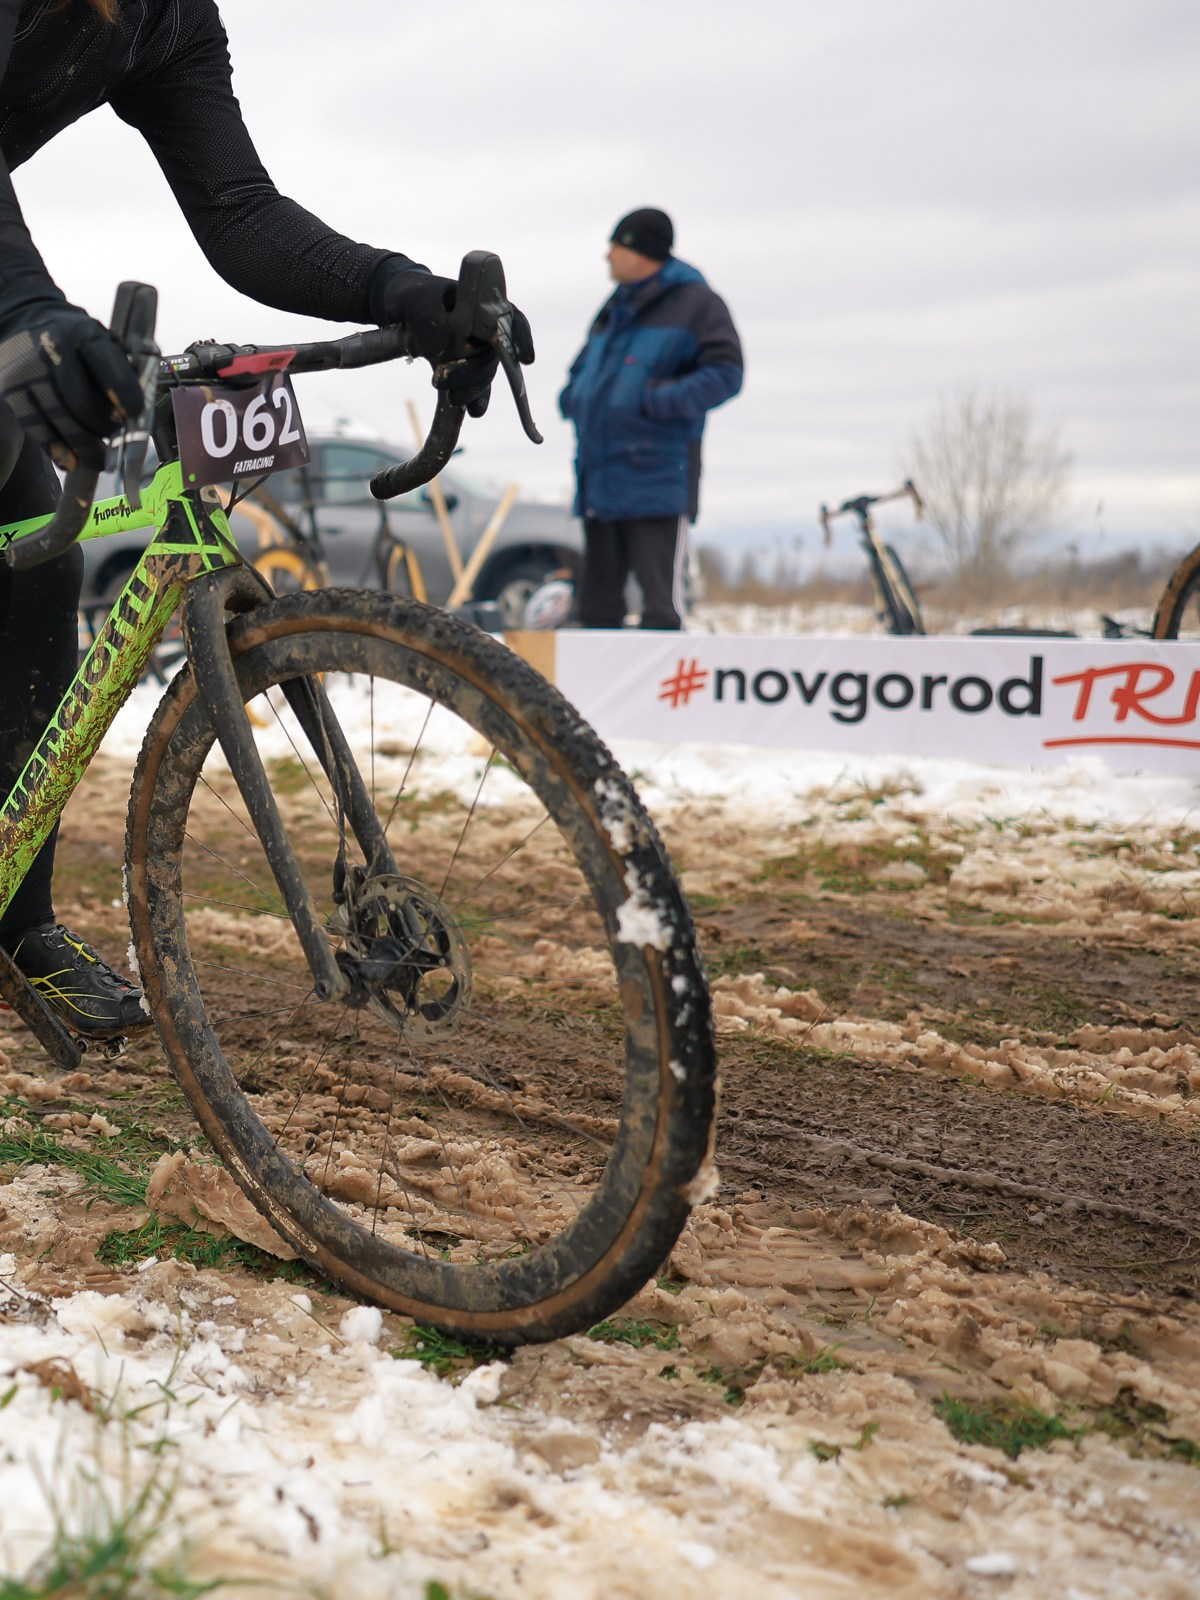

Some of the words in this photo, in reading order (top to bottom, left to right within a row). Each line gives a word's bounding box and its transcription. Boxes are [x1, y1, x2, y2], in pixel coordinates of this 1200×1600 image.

[201, 387, 300, 458] 062
[233, 455, 275, 474] FATRACING
[658, 655, 1043, 724] #novgorod
